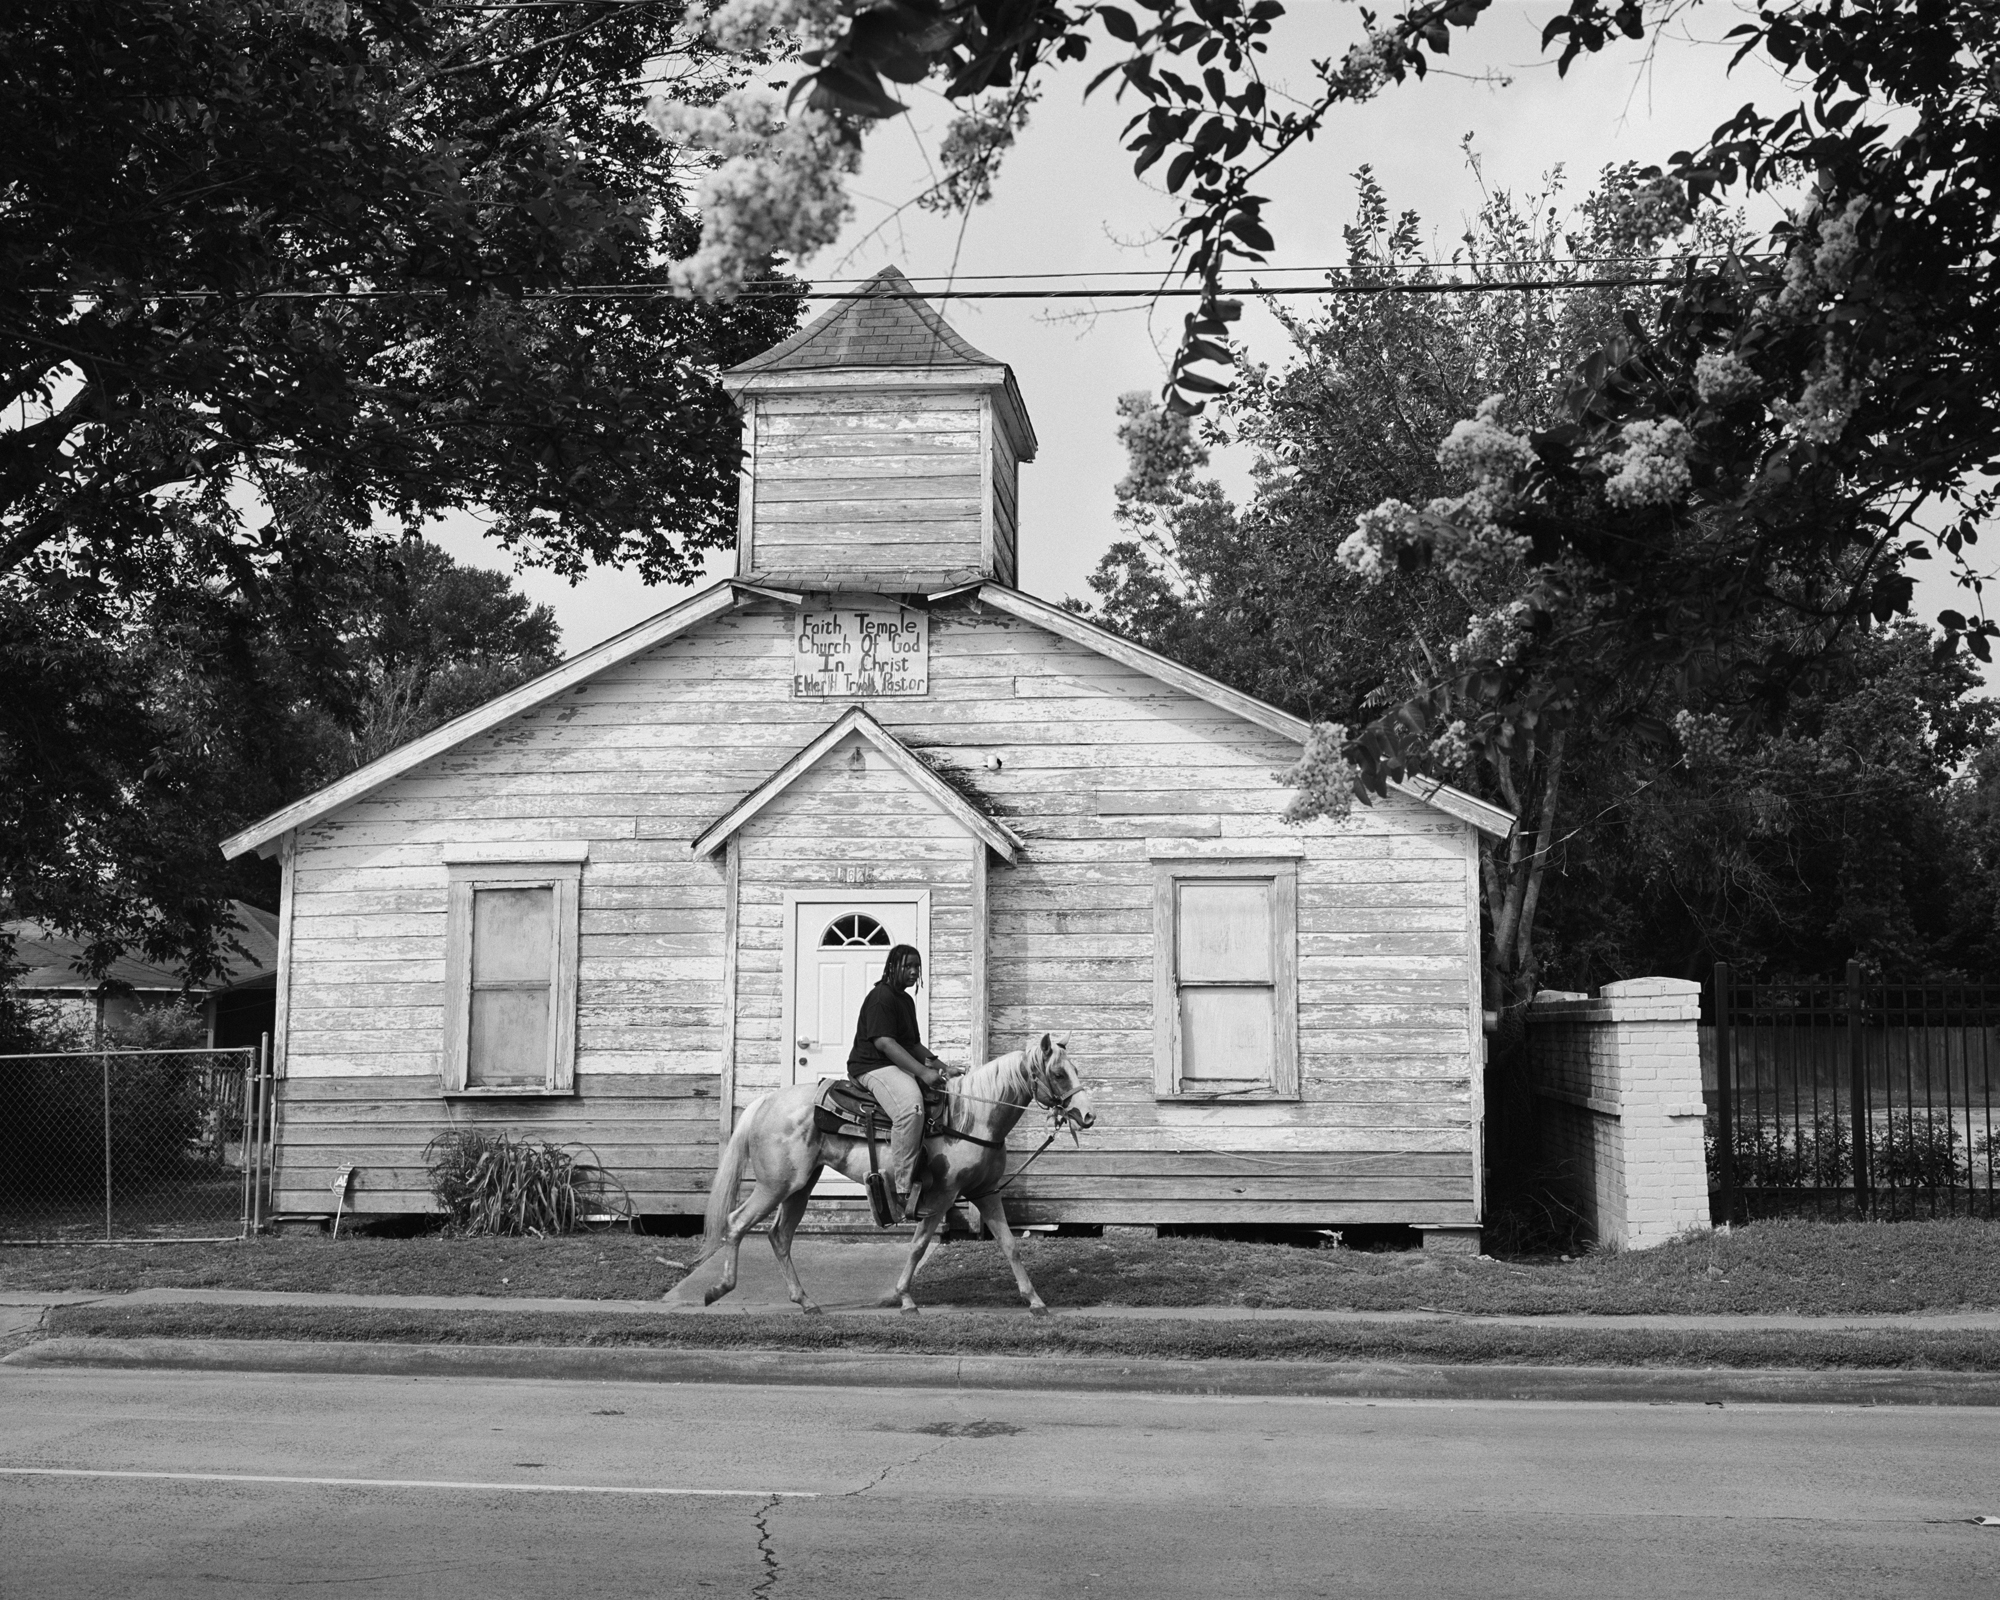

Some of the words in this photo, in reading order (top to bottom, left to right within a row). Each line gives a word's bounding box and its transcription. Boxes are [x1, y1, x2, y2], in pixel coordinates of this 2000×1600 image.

[803, 614, 842, 635] Faith
[854, 613, 917, 642] Temple
[798, 633, 851, 654] Church
[861, 633, 881, 654] Of
[892, 632, 921, 653] God
[818, 653, 845, 672] In
[861, 653, 909, 672] Christ
[883, 672, 925, 692] Pastor
